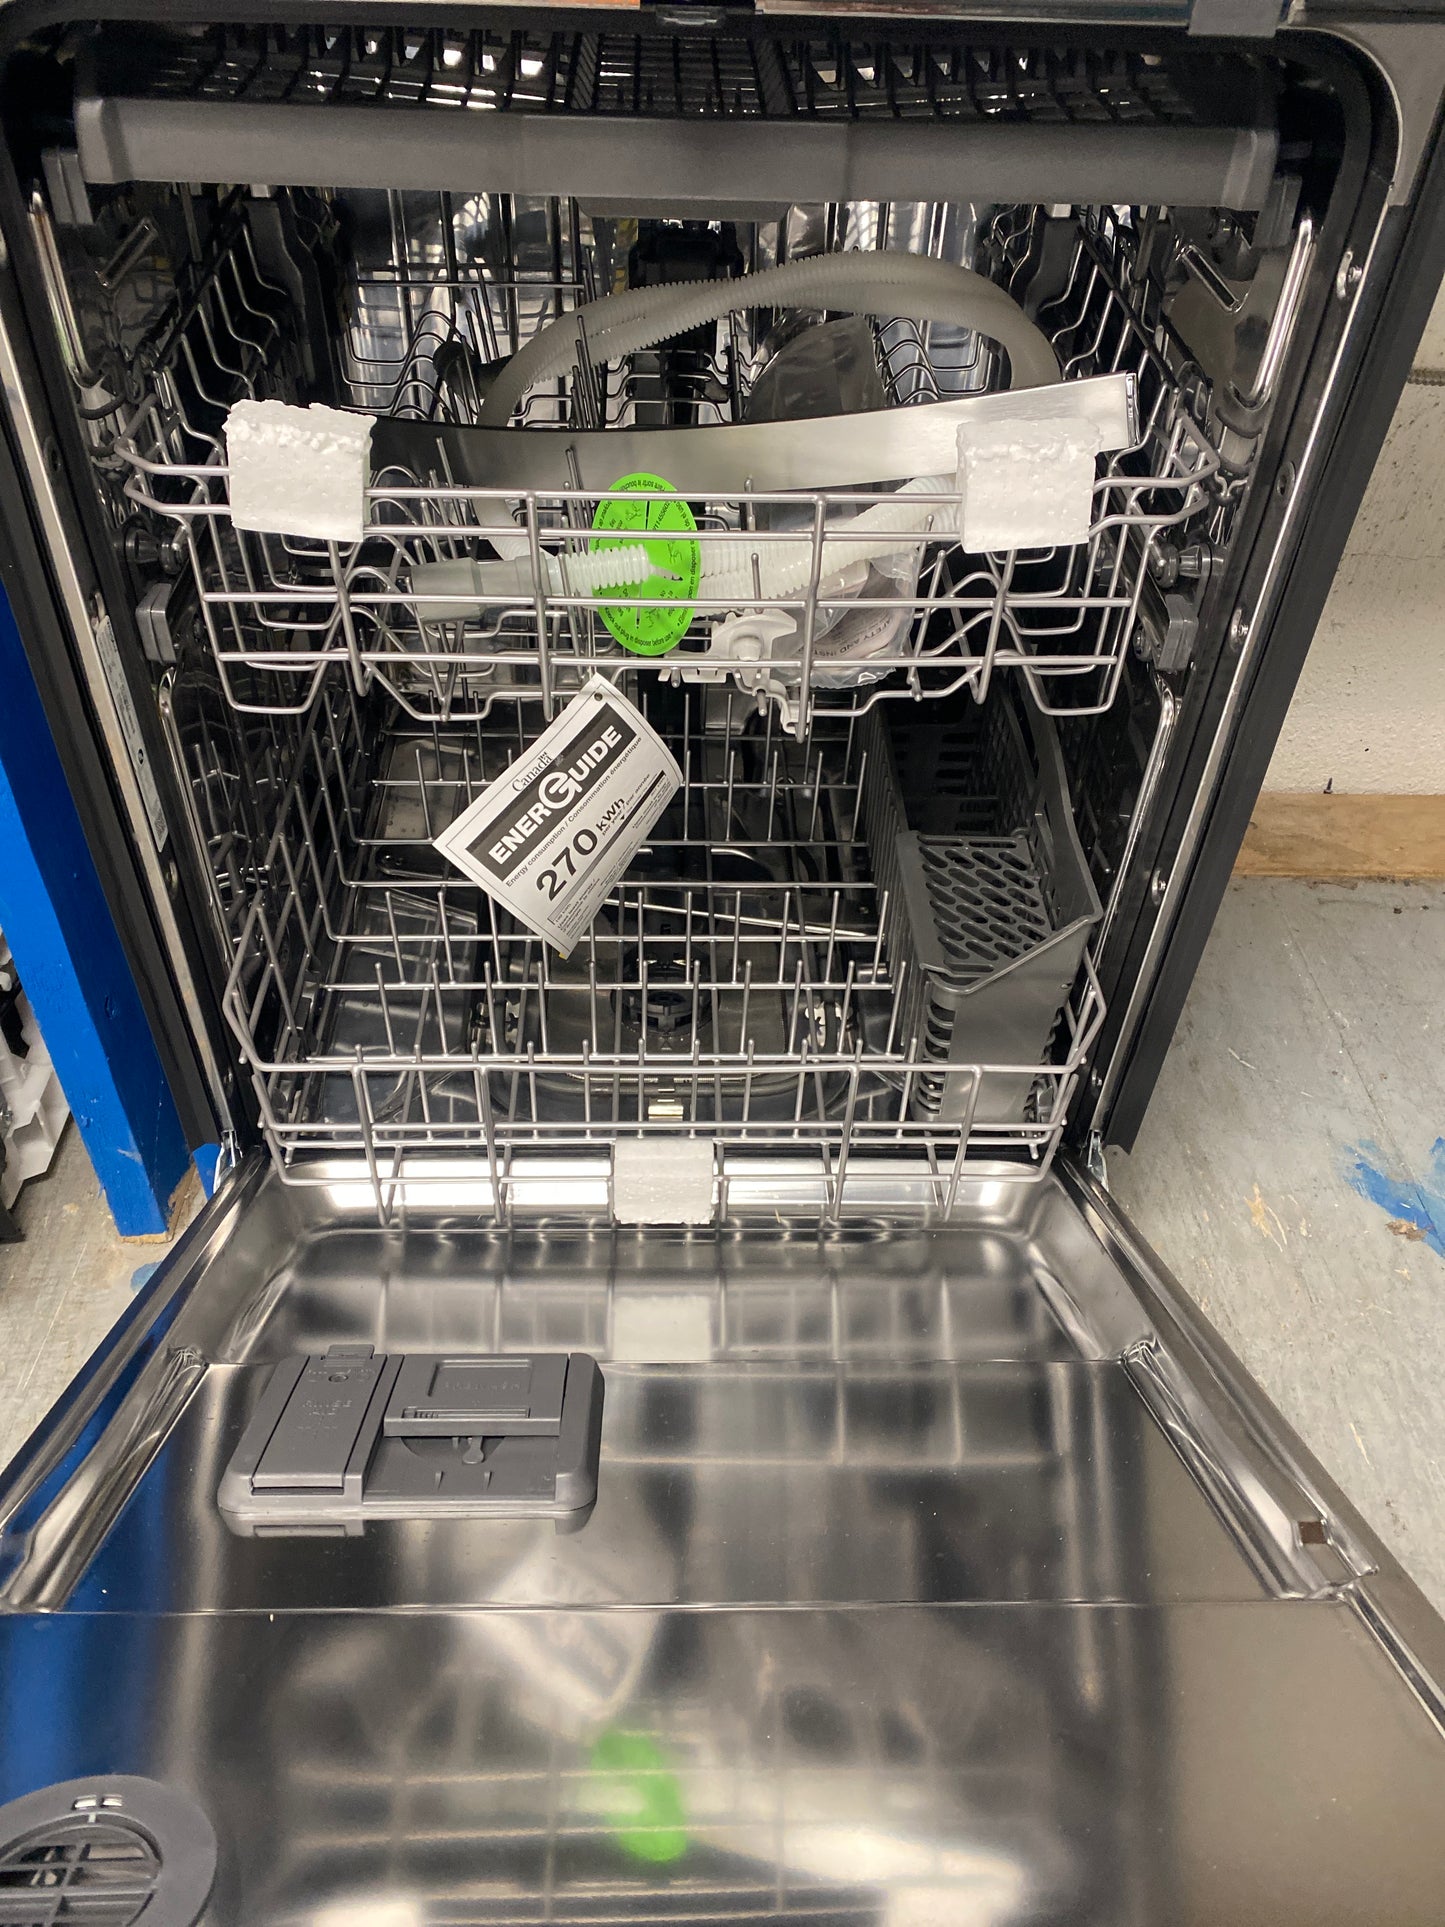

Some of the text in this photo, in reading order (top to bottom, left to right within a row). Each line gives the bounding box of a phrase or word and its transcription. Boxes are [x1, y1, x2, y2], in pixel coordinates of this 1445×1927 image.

[840, 618, 892, 653] AFETY AND
[488, 725, 622, 864] ENERGUIDE
[505, 862, 529, 889] Energy
[526, 823, 566, 868] consumption
[567, 772, 611, 823] Consommation
[610, 736, 642, 778] énergétique
[512, 756, 552, 792] Canada
[536, 828, 598, 900] 270
[596, 797, 626, 832] kWh
